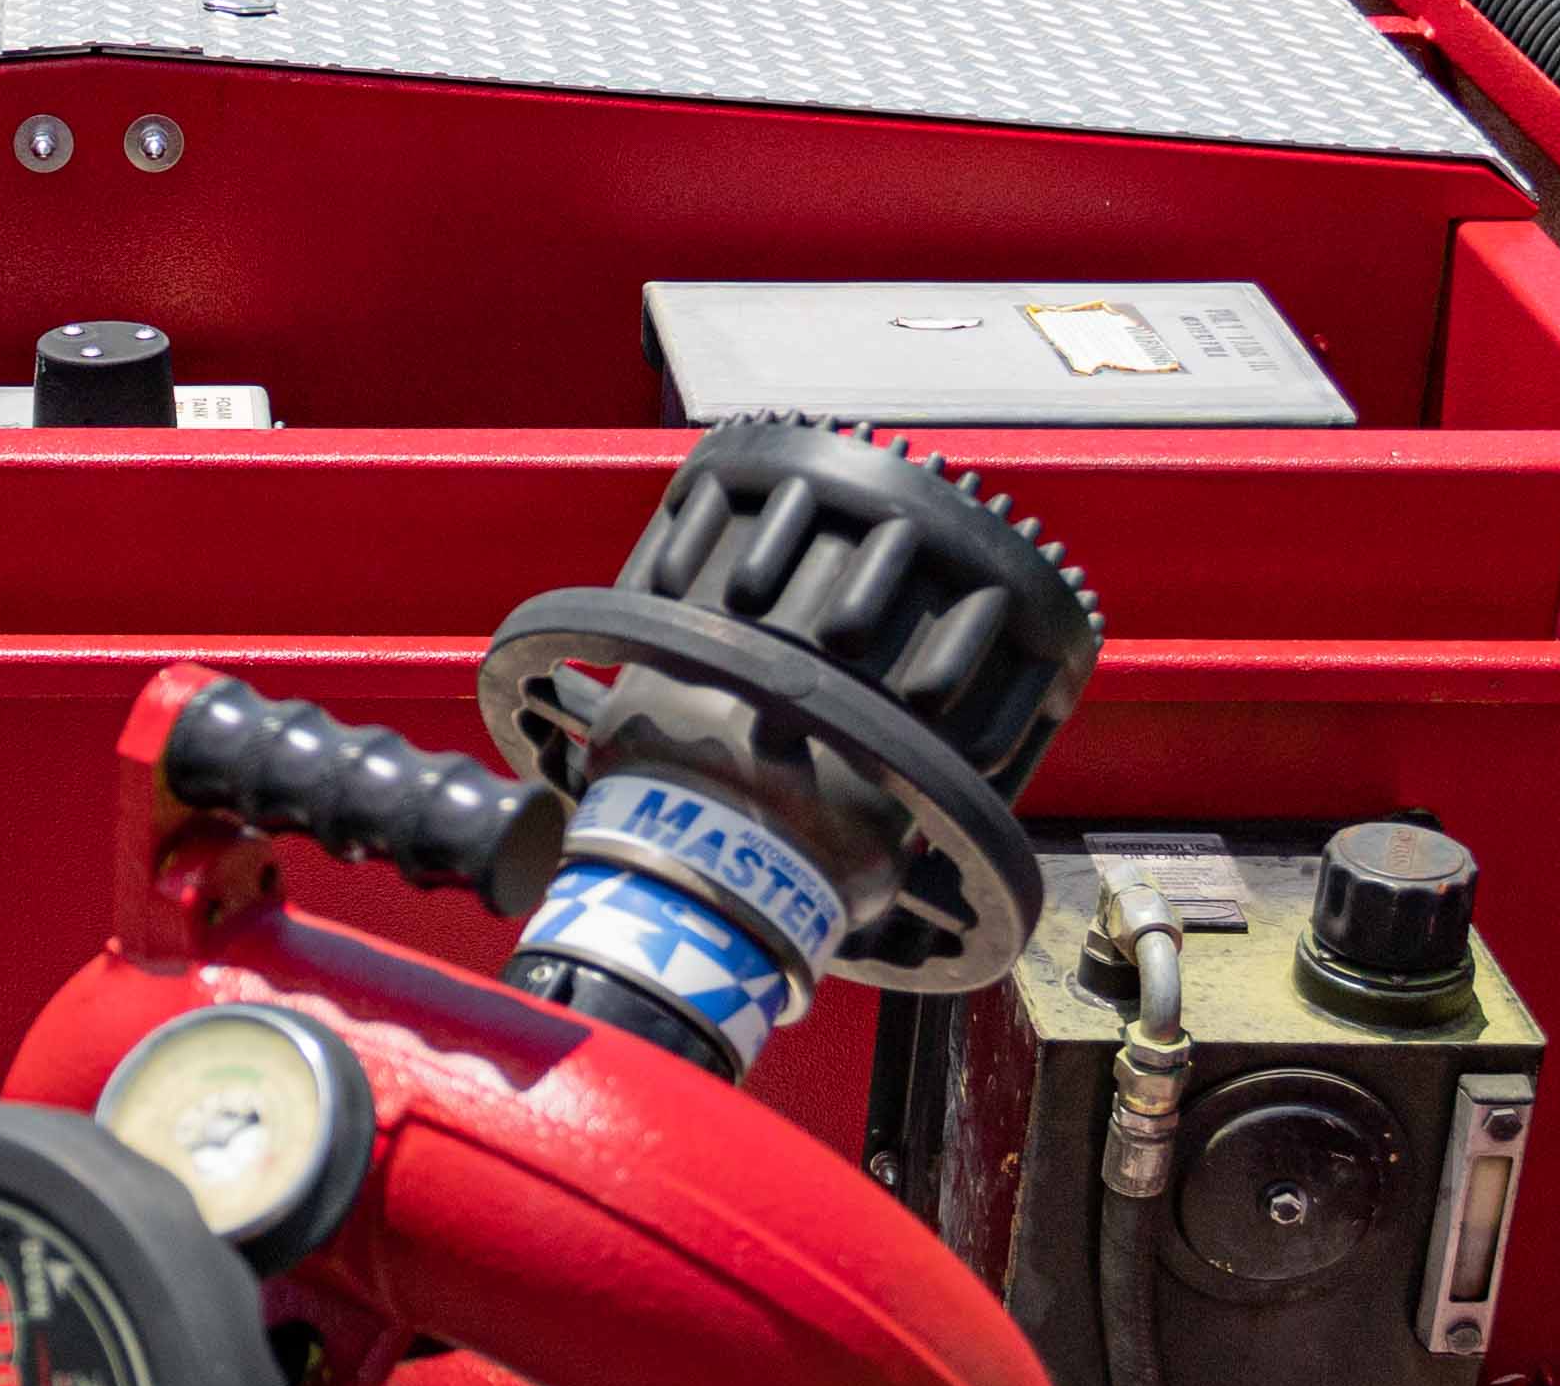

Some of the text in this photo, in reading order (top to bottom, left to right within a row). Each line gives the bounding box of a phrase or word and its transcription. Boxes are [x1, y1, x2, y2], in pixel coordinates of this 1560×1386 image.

[1123, 324, 1181, 366] WARNING
[191, 397, 208, 420] TANK
[215, 396, 233, 421] FOAM
[1104, 842, 1209, 851] HYDRAULIC
[1154, 851, 1199, 862] ONLY
[620, 788, 830, 957] MASTER
[20, 1237, 52, 1320] DOWN
